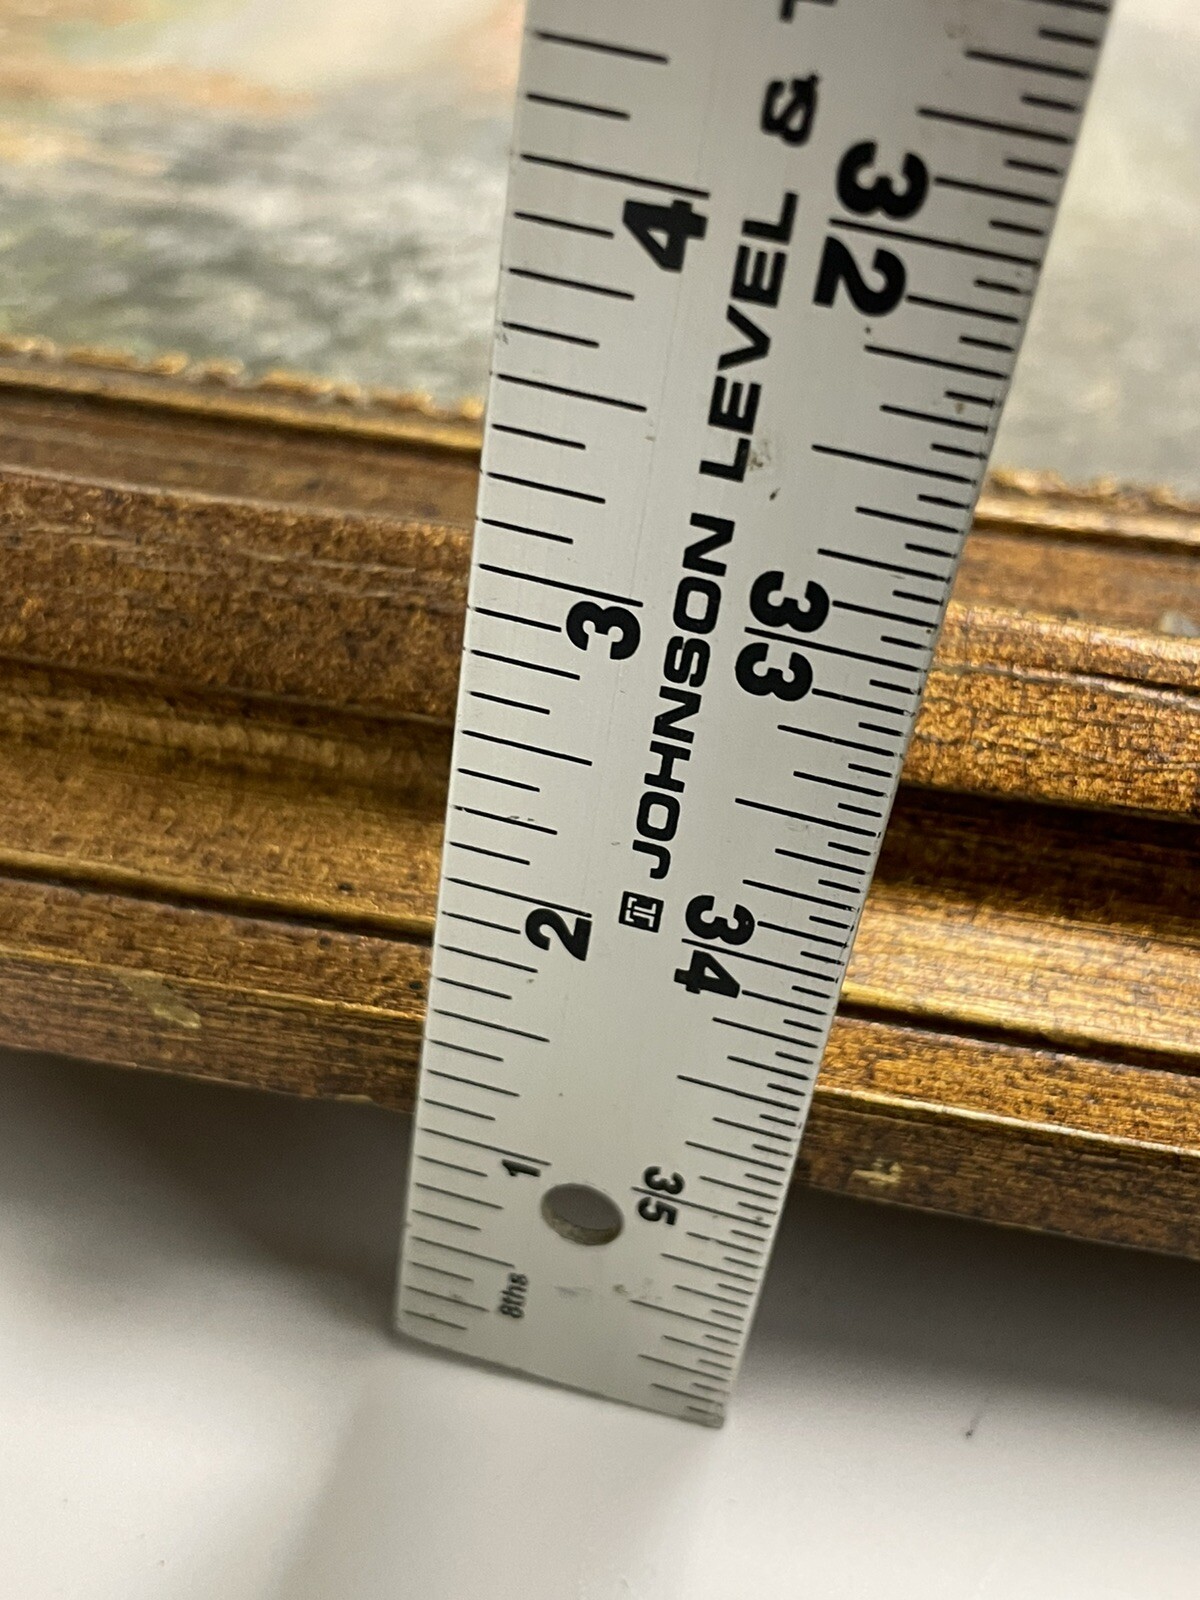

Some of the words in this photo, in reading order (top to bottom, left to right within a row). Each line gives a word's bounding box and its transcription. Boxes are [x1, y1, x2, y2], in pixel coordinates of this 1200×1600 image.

[622, 199, 708, 273] 4
[812, 139, 930, 318] 32
[632, 512, 736, 880] JOHNSON
[699, 191, 798, 482] LEVEL
[761, 74, 819, 147] &
[565, 601, 641, 661] 3
[735, 570, 830, 702] 33
[525, 907, 592, 962] 2
[673, 894, 755, 999] 34
[501, 1159, 541, 1178] 1
[637, 1165, 685, 1226] 35
[498, 1271, 529, 1320] 8ths
